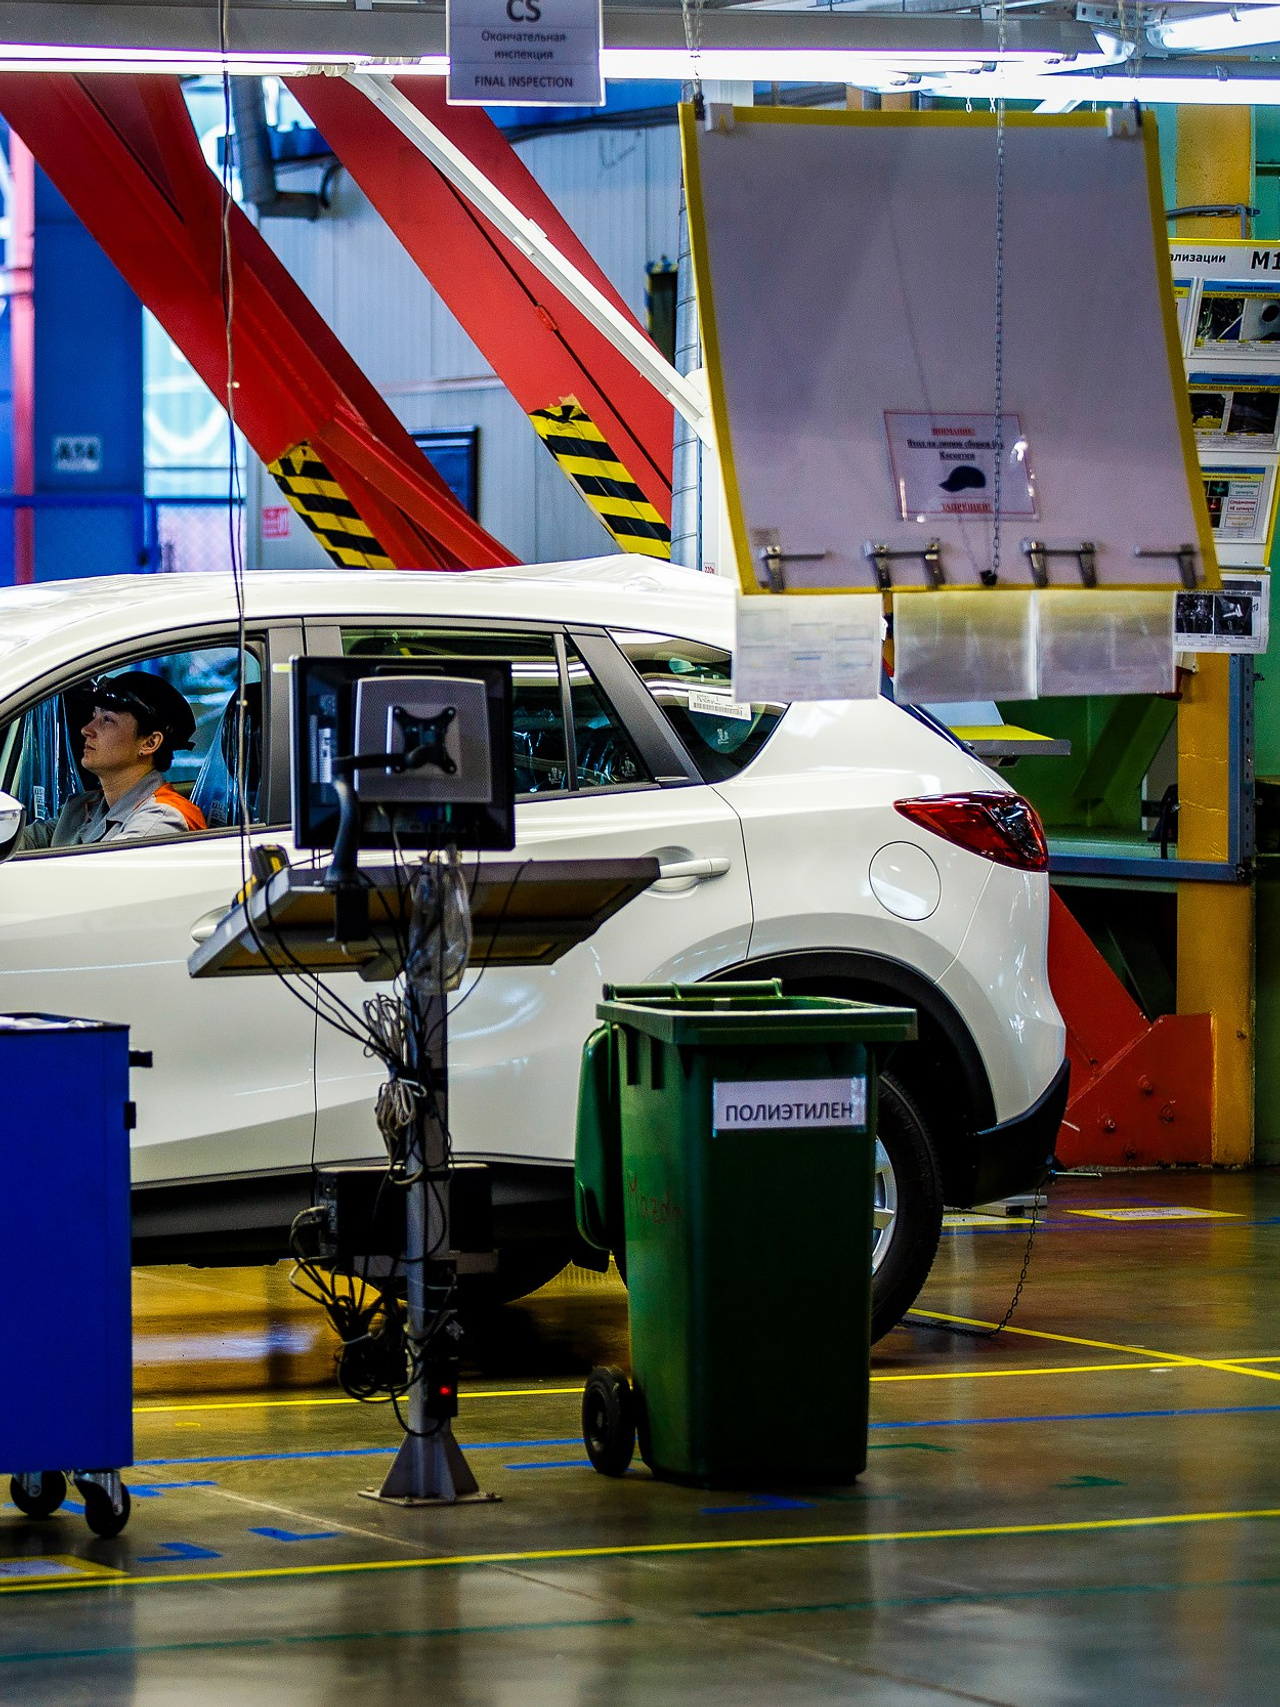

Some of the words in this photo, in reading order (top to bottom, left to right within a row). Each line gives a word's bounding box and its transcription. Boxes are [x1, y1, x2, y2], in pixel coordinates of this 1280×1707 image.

[506, 0, 542, 23] CS
[481, 30, 567, 43] Окончательная
[494, 51, 554, 61] инспекция
[474, 75, 506, 87] FINAL
[508, 76, 574, 88] INSPECTION
[726, 1102, 854, 1122] ПОЛИЭТИЛЕН
